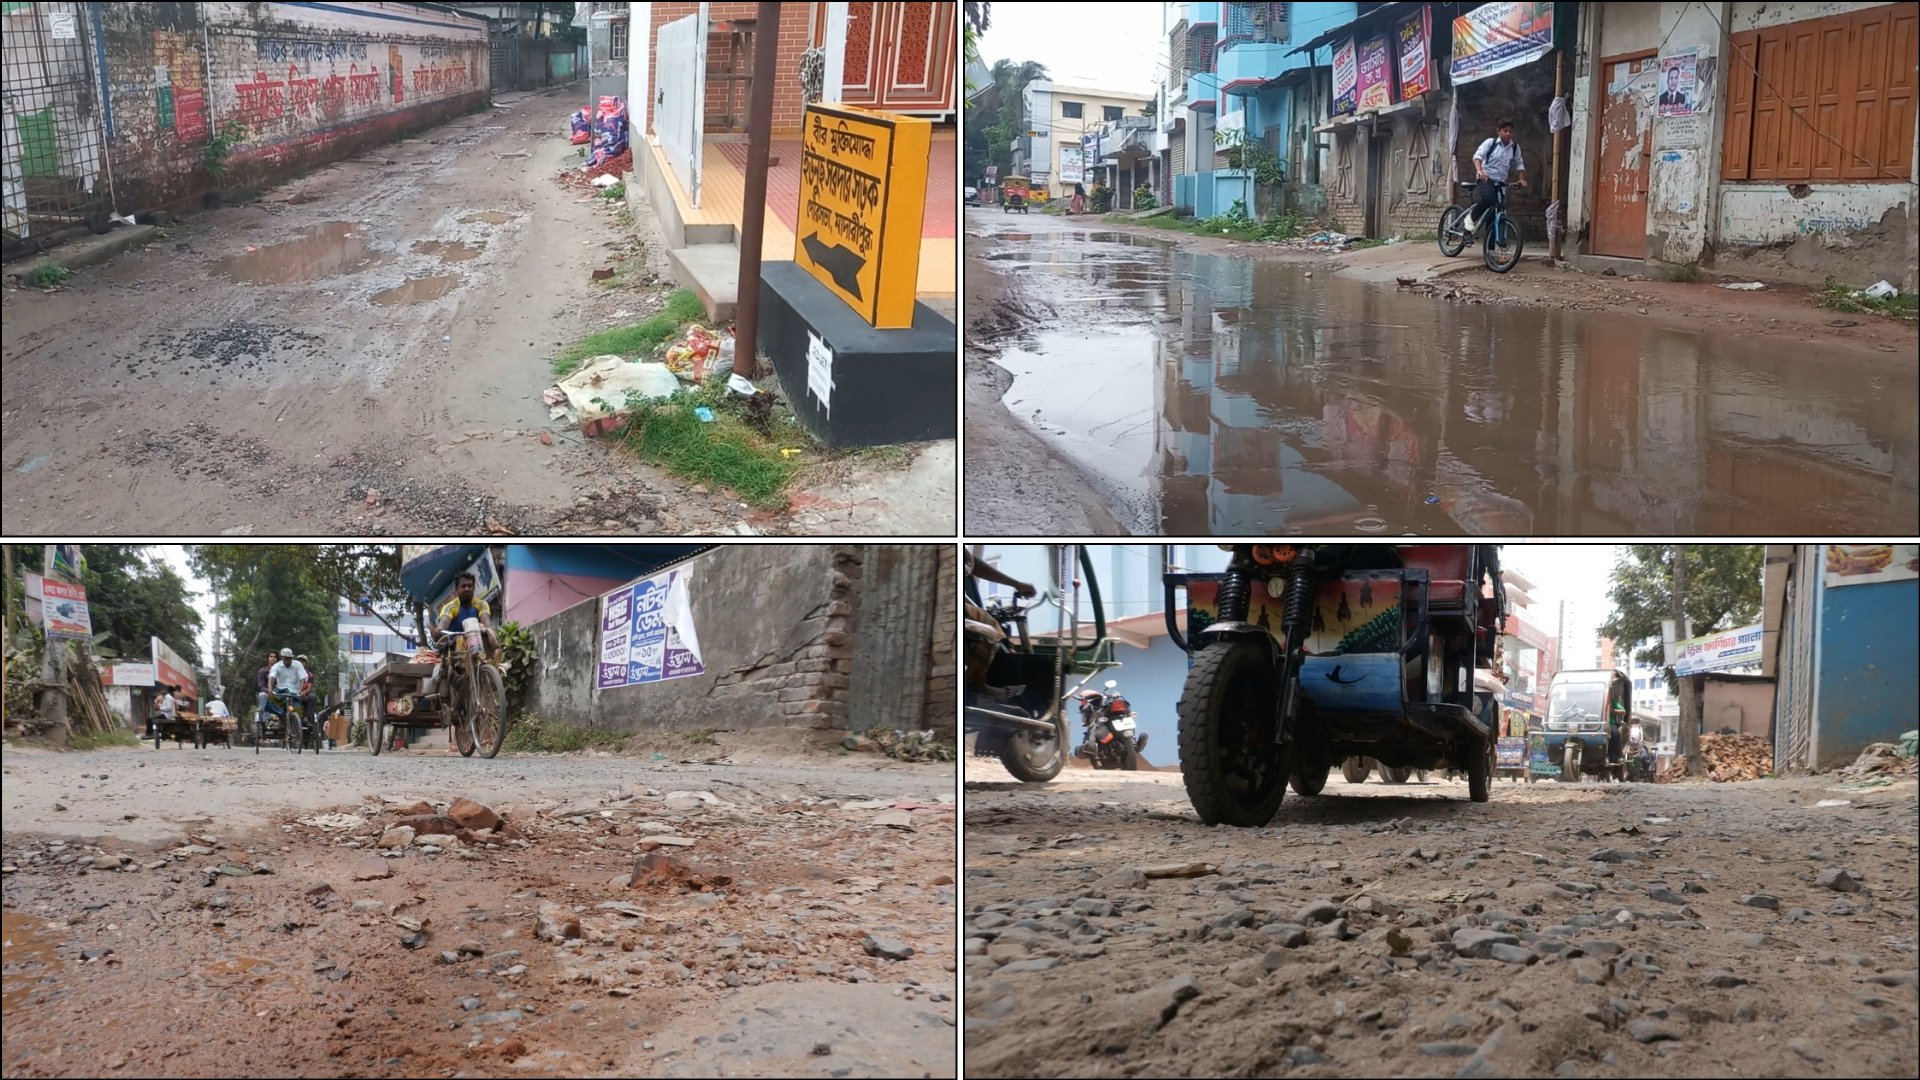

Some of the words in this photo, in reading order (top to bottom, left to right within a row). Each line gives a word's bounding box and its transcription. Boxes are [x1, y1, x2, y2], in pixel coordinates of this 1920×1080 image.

[813, 115, 828, 146] বীর
[830, 120, 875, 160] মুক্তিযোদ্ধা
[825, 158, 852, 204] সরদার
[852, 168, 881, 218] সড়ক
[608, 599, 628, 622] HSC
[636, 586, 668, 613] নটর
[601, 664, 621, 680] উদ্ভাস
